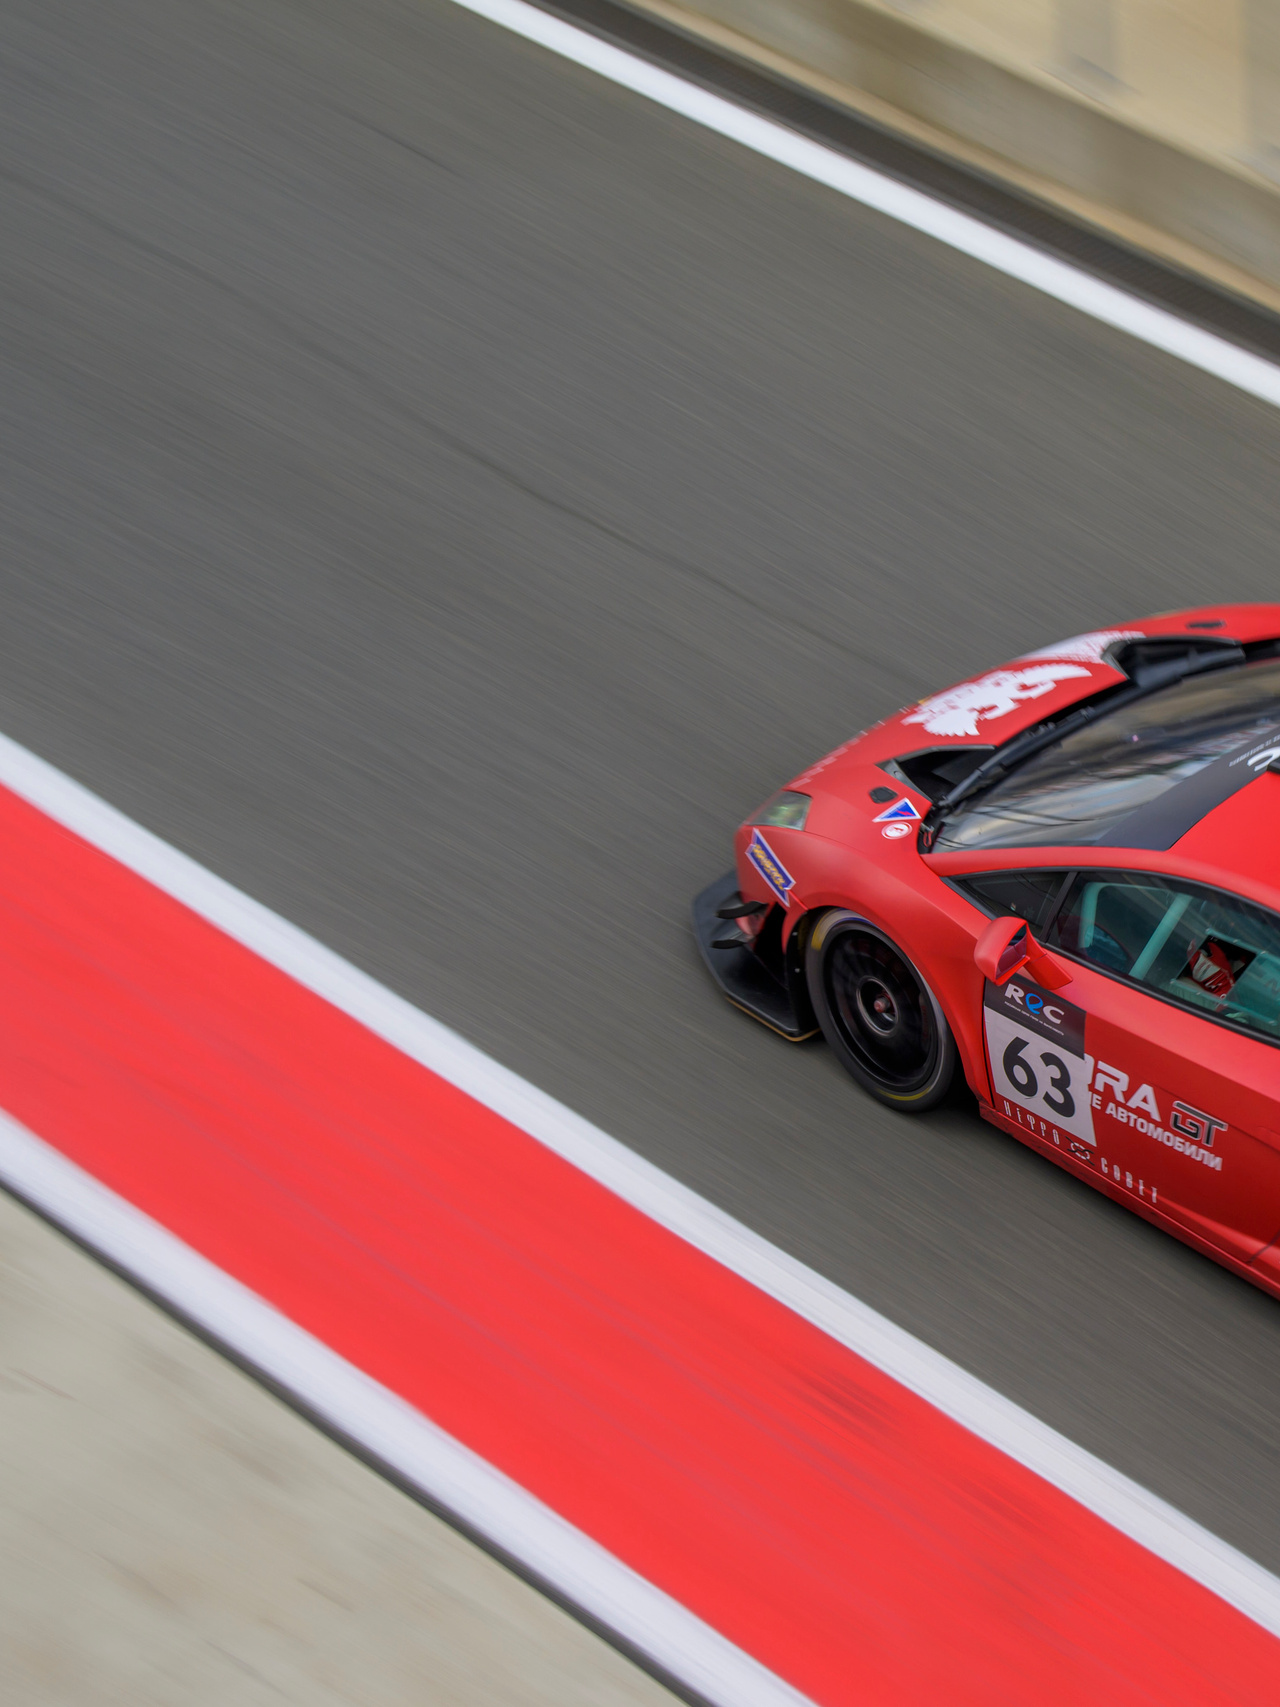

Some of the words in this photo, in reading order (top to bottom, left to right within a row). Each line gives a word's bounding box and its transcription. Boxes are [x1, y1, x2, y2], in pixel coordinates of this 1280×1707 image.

[1002, 1036, 1076, 1118] 63
[1105, 1102, 1223, 1171] АВТОМОБИЛИ
[1100, 1157, 1158, 1204] СОВЕТ
